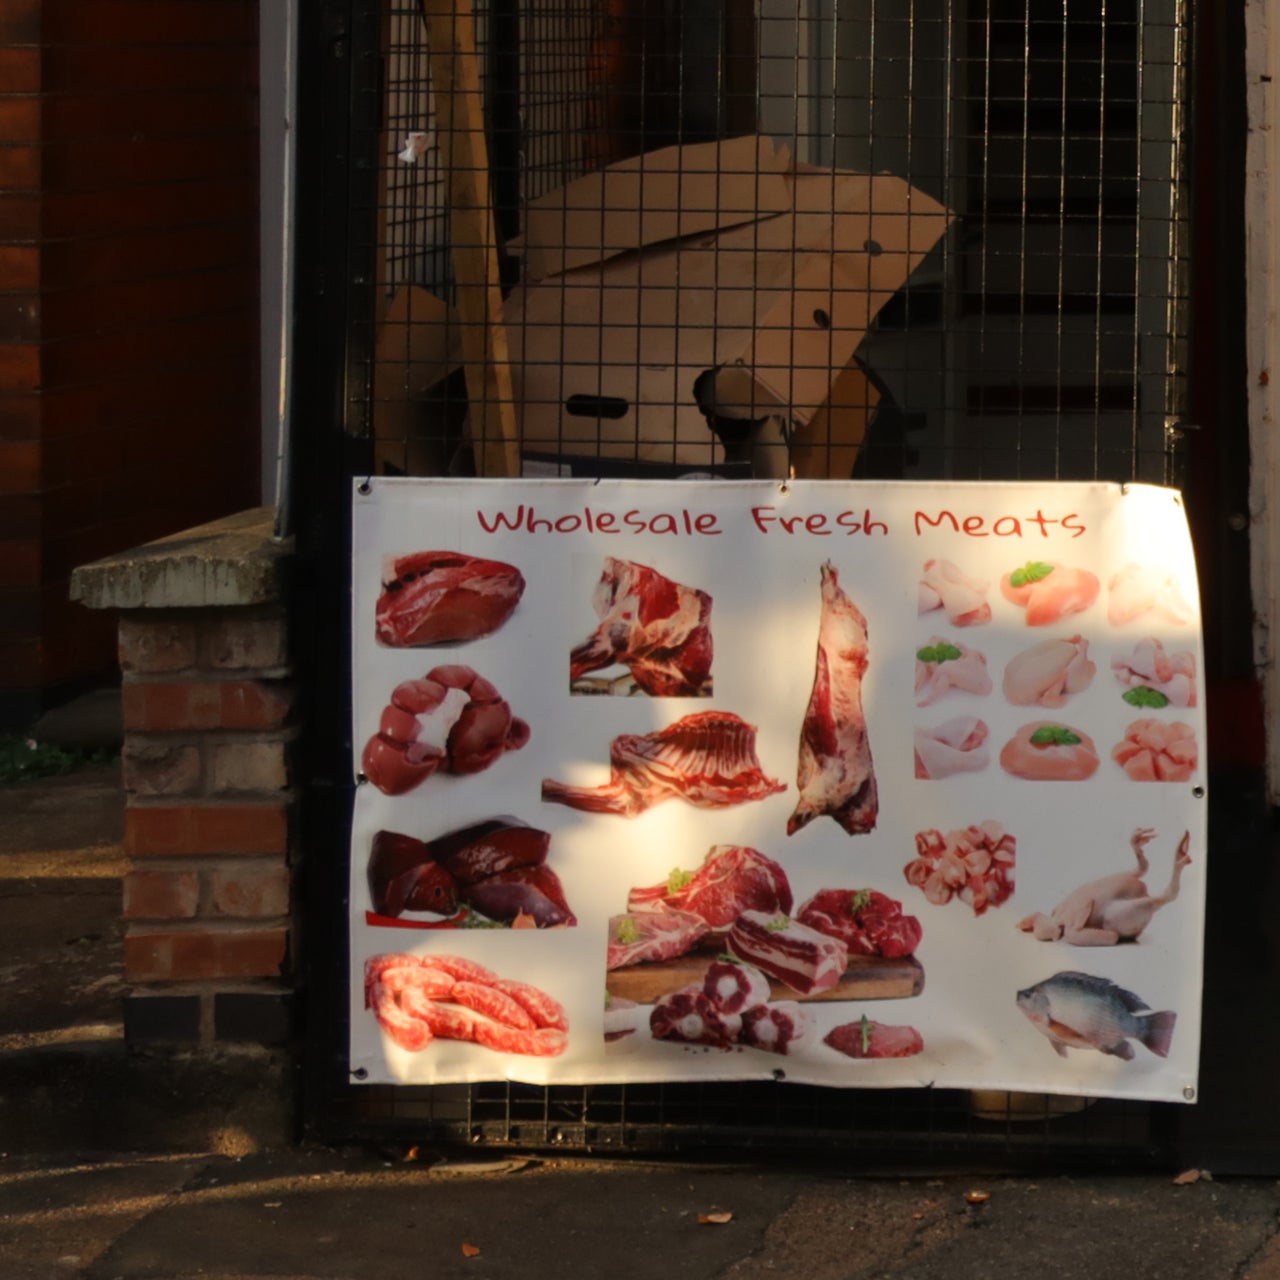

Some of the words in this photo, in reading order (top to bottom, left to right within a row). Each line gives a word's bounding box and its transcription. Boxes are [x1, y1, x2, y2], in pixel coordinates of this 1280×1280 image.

[477, 505, 722, 536] Wholesale
[751, 506, 890, 537] Fresh
[914, 509, 1087, 538] Meats
